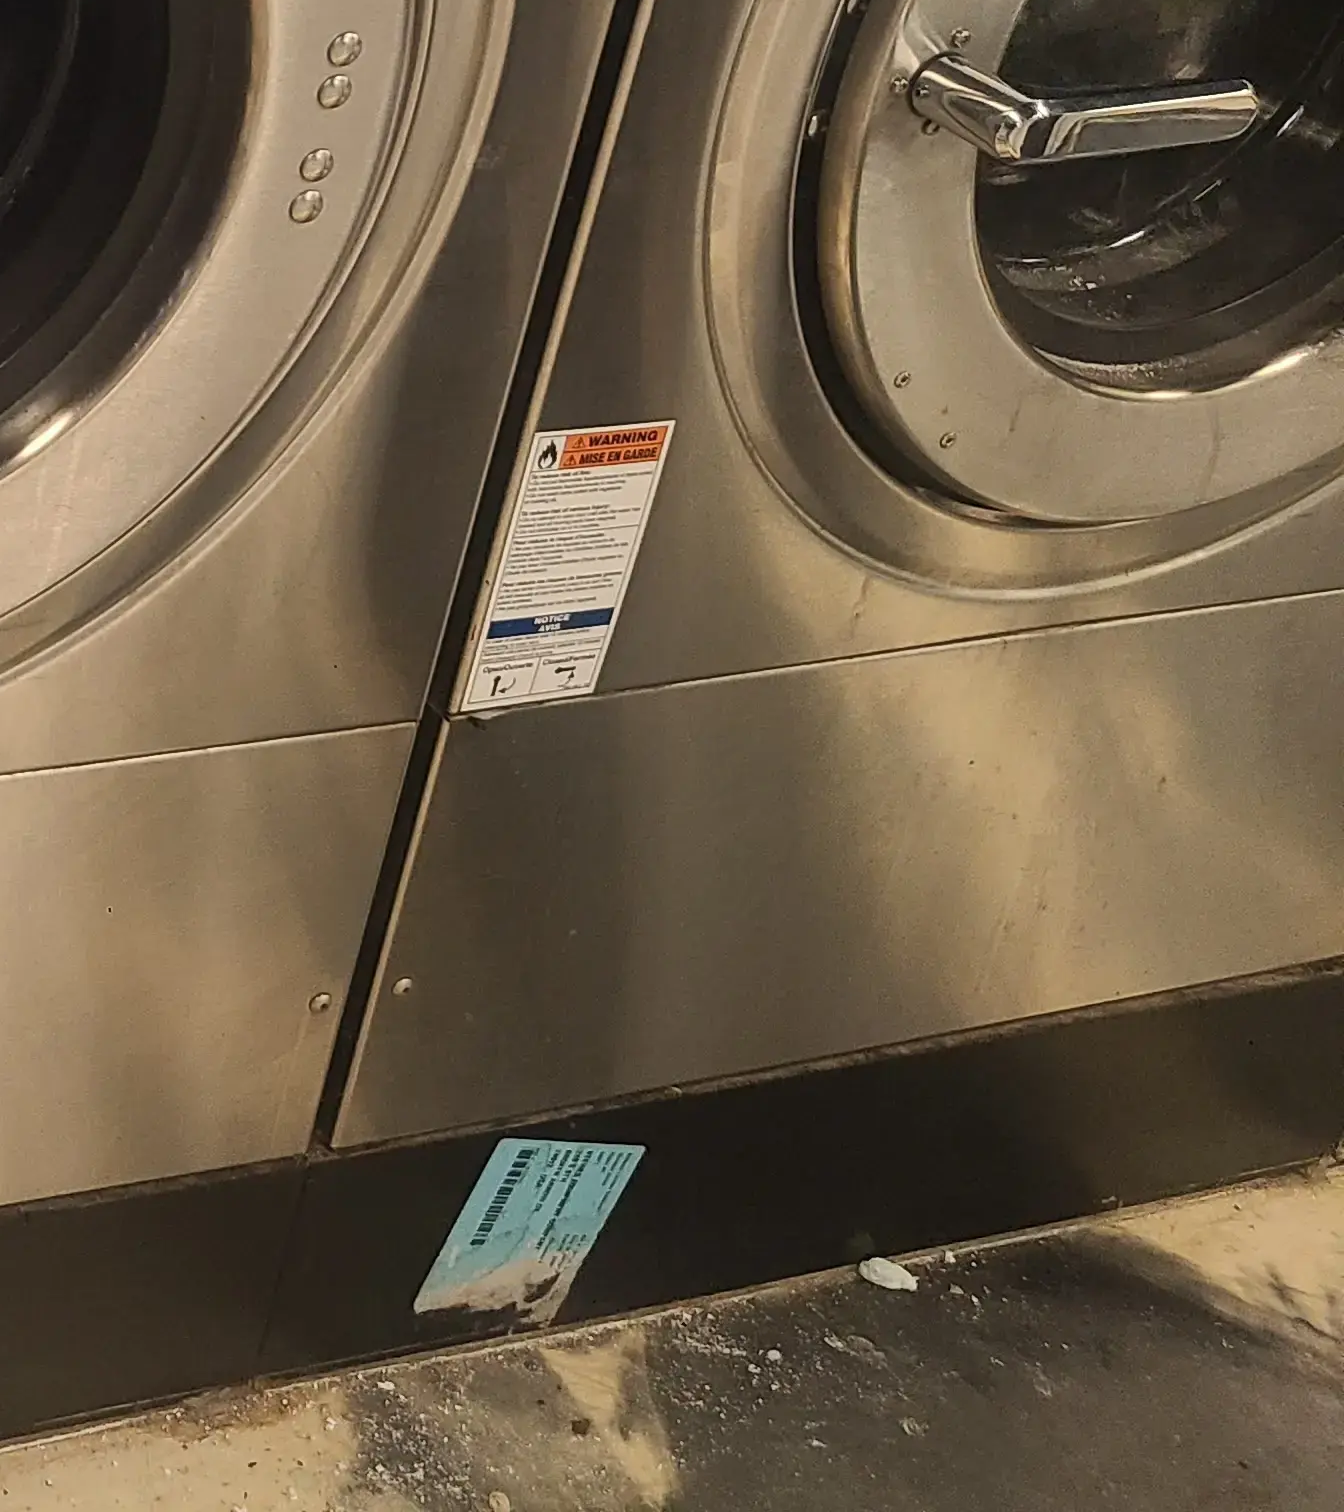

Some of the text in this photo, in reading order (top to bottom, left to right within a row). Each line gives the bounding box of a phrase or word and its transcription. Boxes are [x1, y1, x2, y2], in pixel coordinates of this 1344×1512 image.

[587, 430, 659, 447] WARNING
[578, 446, 658, 464] MISE EN GARDE
[532, 613, 571, 625] NOTICE
